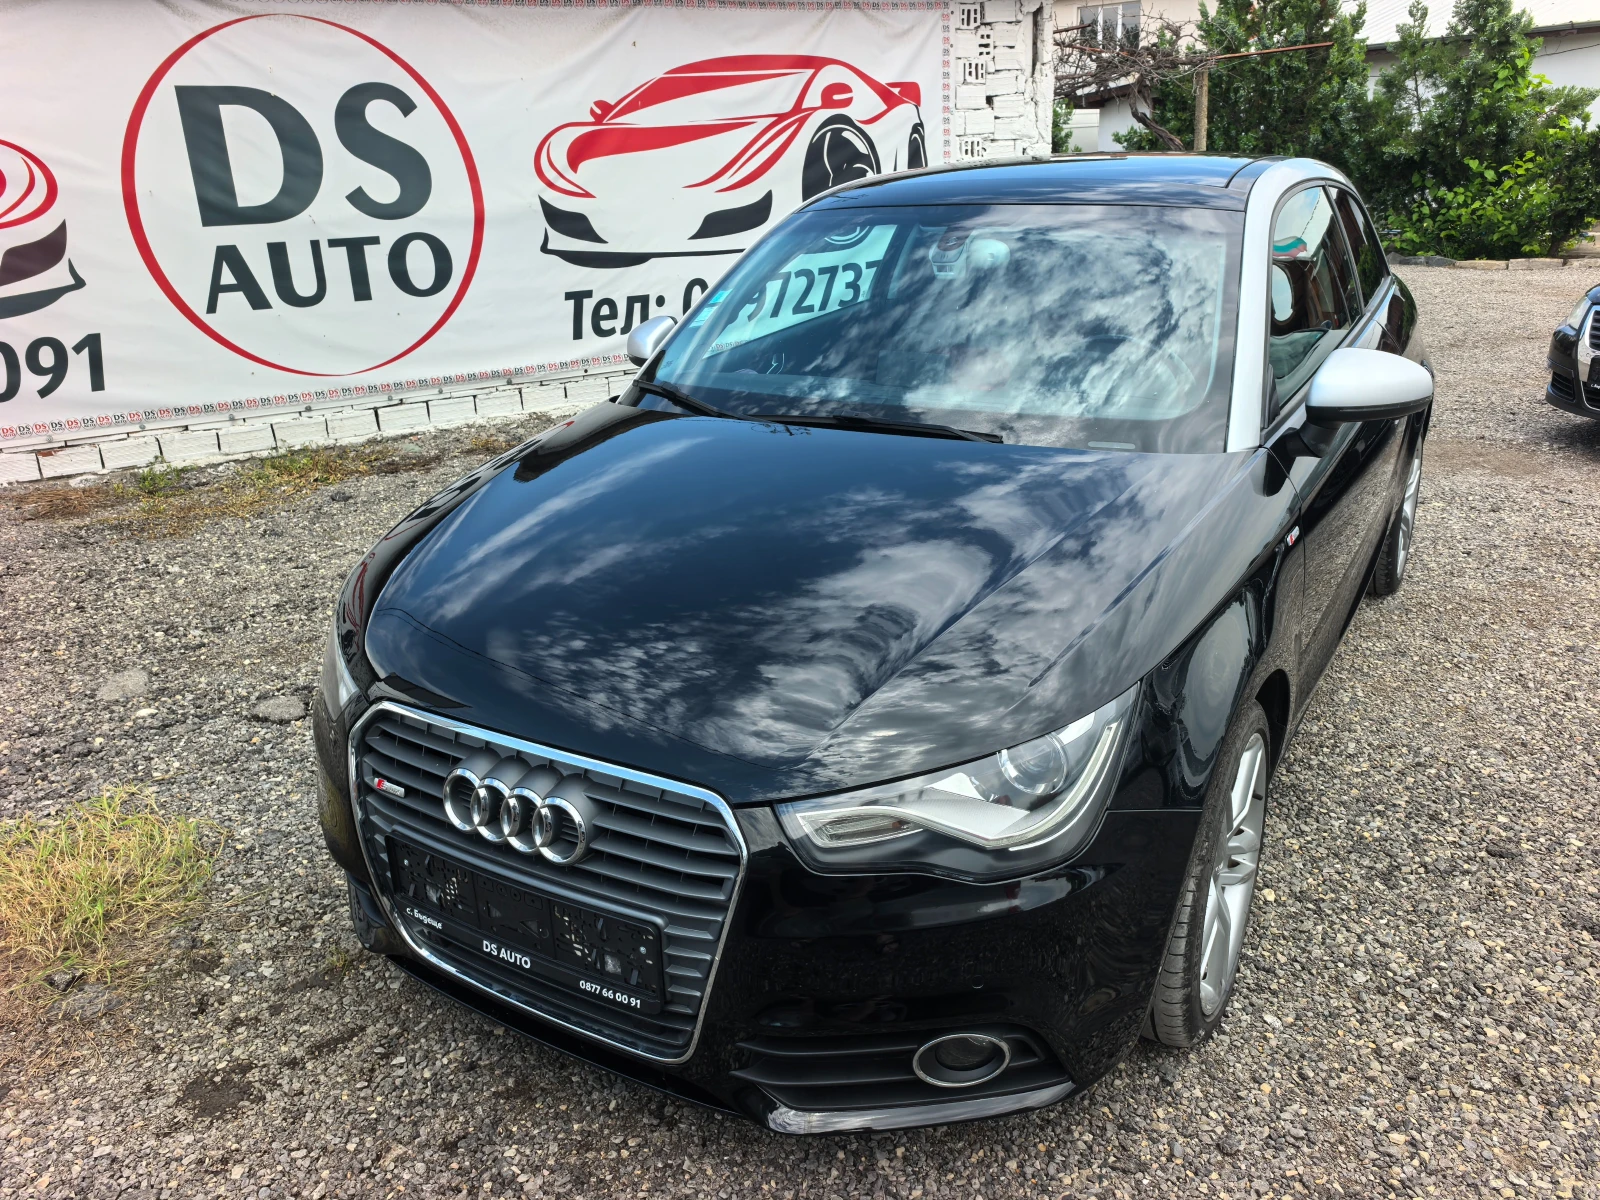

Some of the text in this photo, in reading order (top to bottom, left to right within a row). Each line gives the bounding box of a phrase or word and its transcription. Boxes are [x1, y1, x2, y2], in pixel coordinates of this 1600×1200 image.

[174, 82, 432, 227] DS
[206, 231, 454, 314] AUTO
[482, 940, 531, 969] DS AUTO
[580, 980, 641, 1009] 0877 66 00 91
